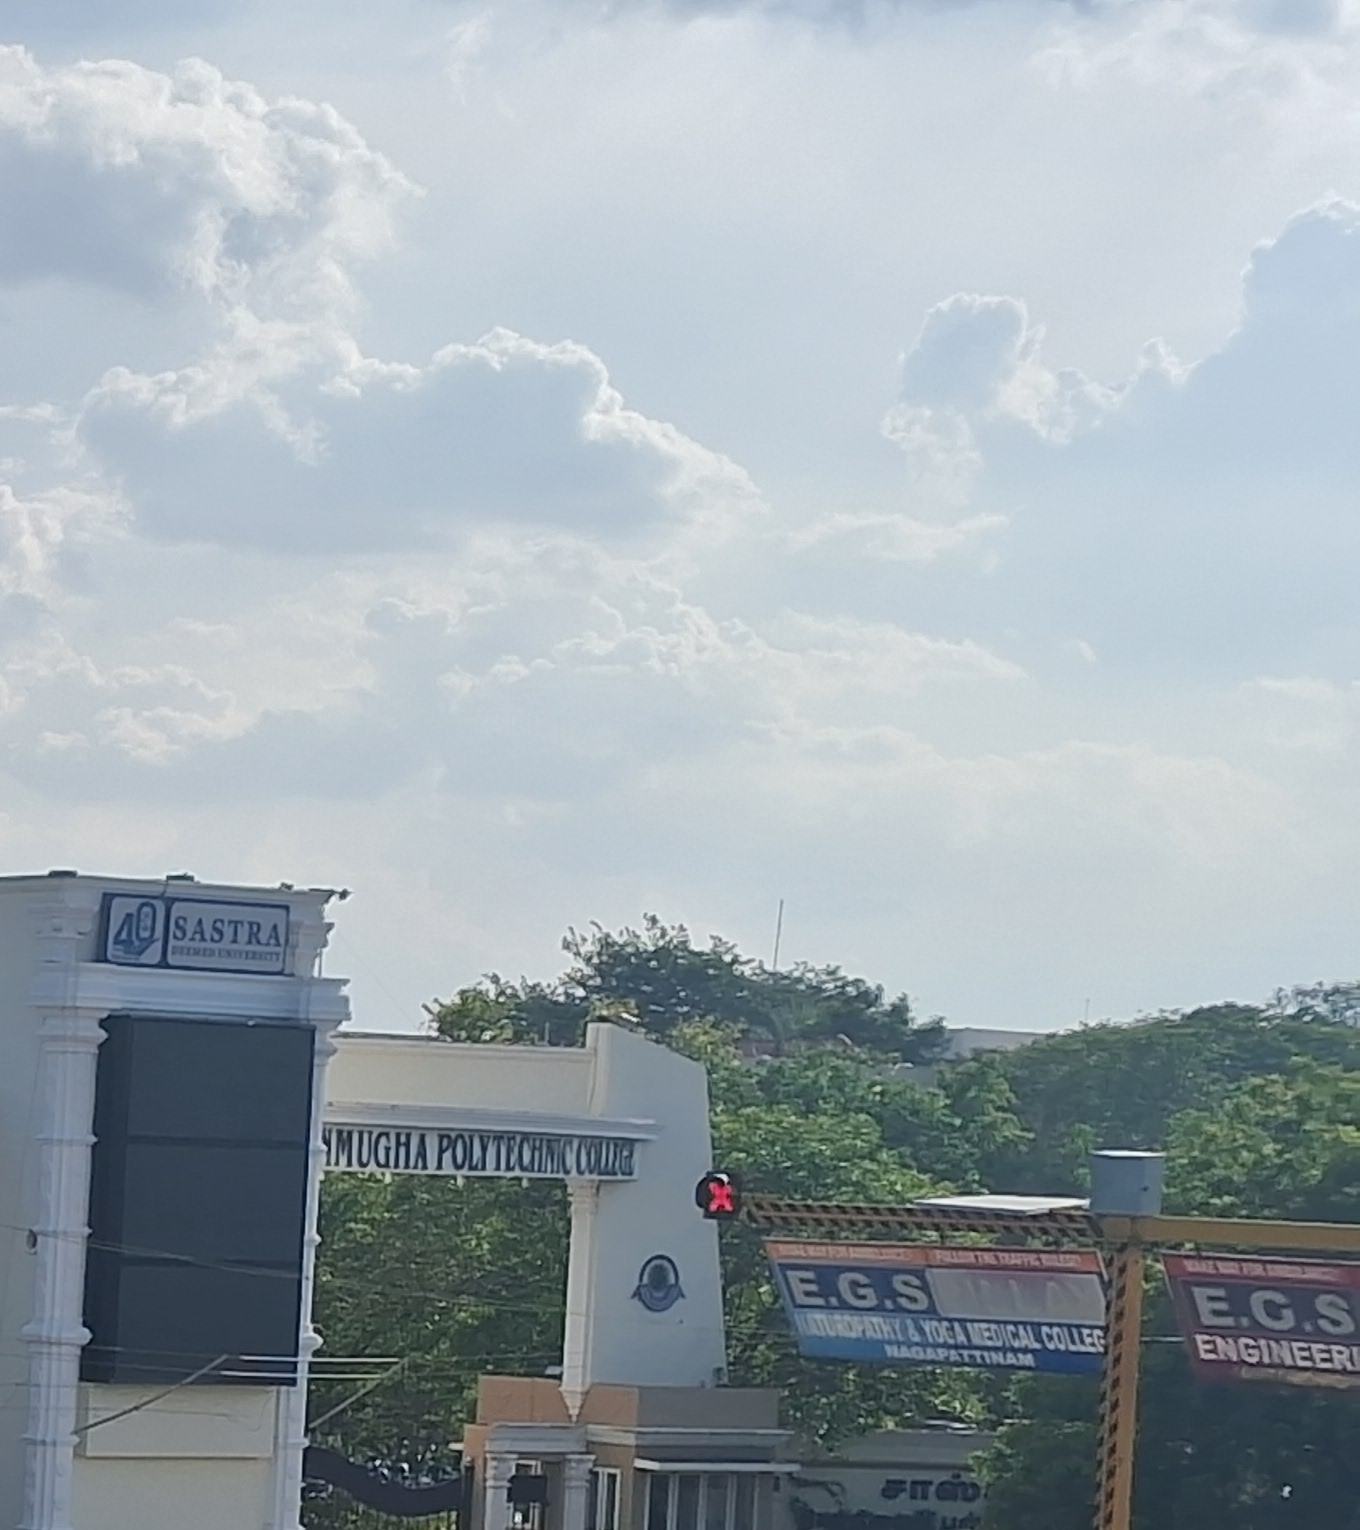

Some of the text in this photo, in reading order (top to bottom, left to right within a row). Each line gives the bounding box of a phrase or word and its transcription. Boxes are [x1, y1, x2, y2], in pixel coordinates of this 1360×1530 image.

[172, 915, 282, 947] SASTRA
[436, 1132, 574, 1176] POLYTECHNIC
[575, 1138, 636, 1178] COLLEGE
[785, 1269, 930, 1311] E.G.S
[920, 1318, 968, 1346] YOGA
[967, 1322, 1042, 1350] MEDICAL
[883, 1343, 1036, 1368] NAGAPATTINAM
